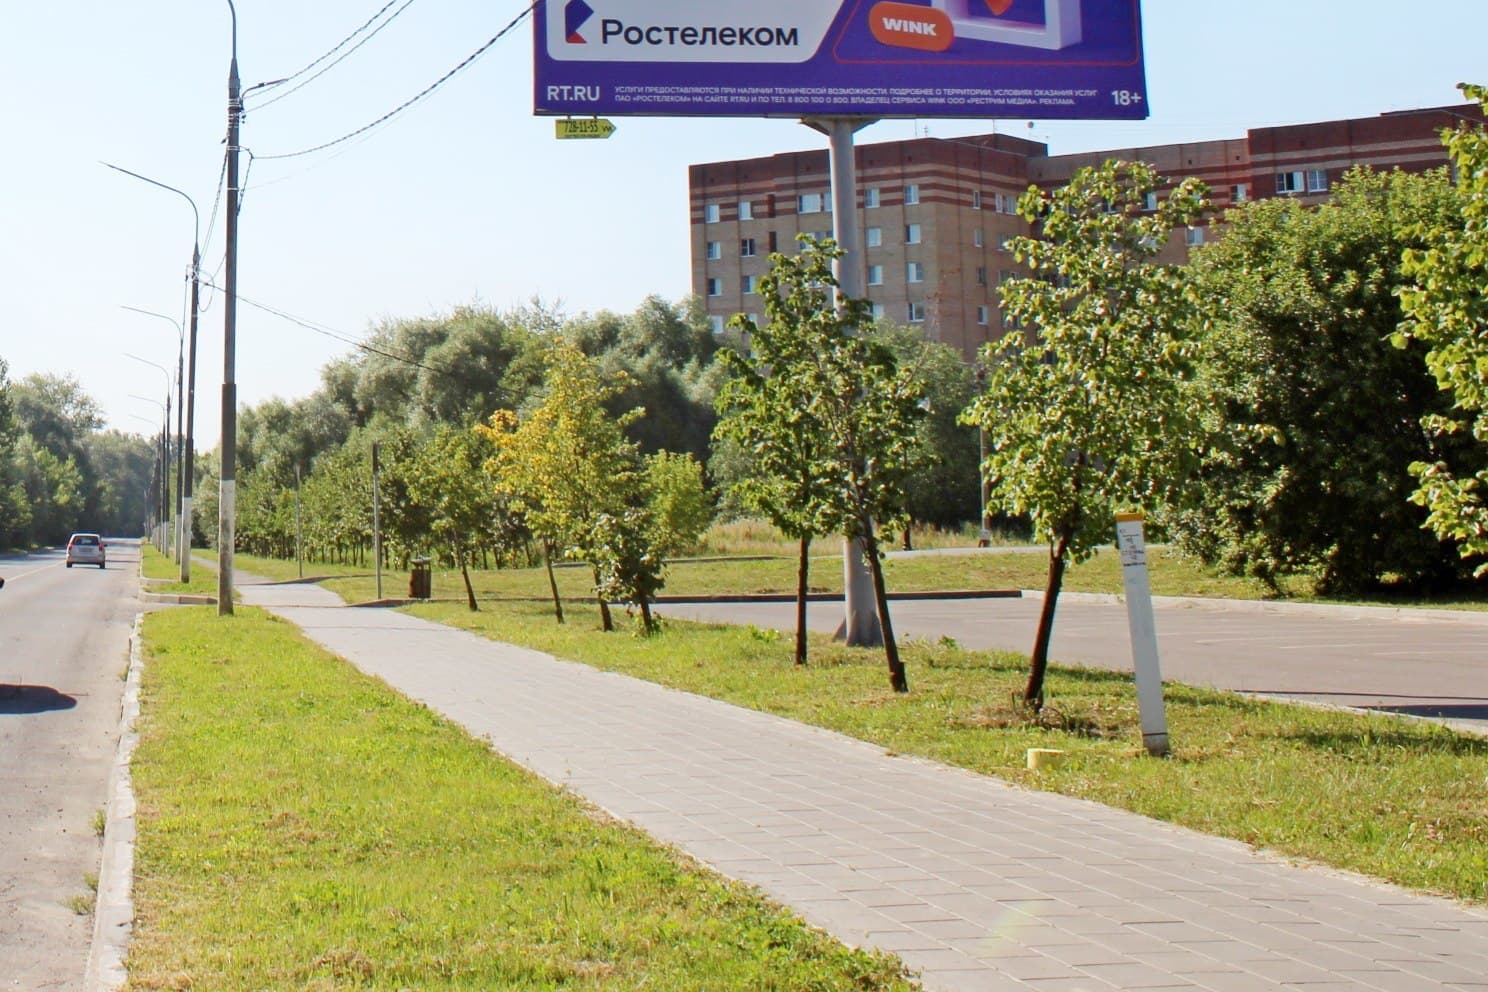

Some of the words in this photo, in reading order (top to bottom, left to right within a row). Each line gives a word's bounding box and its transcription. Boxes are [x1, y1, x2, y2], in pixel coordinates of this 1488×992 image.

[601, 19, 799, 46] Ростелеком
[882, 16, 937, 36] WINK
[547, 86, 600, 101] RT.RU
[1112, 90, 1142, 105] 18+
